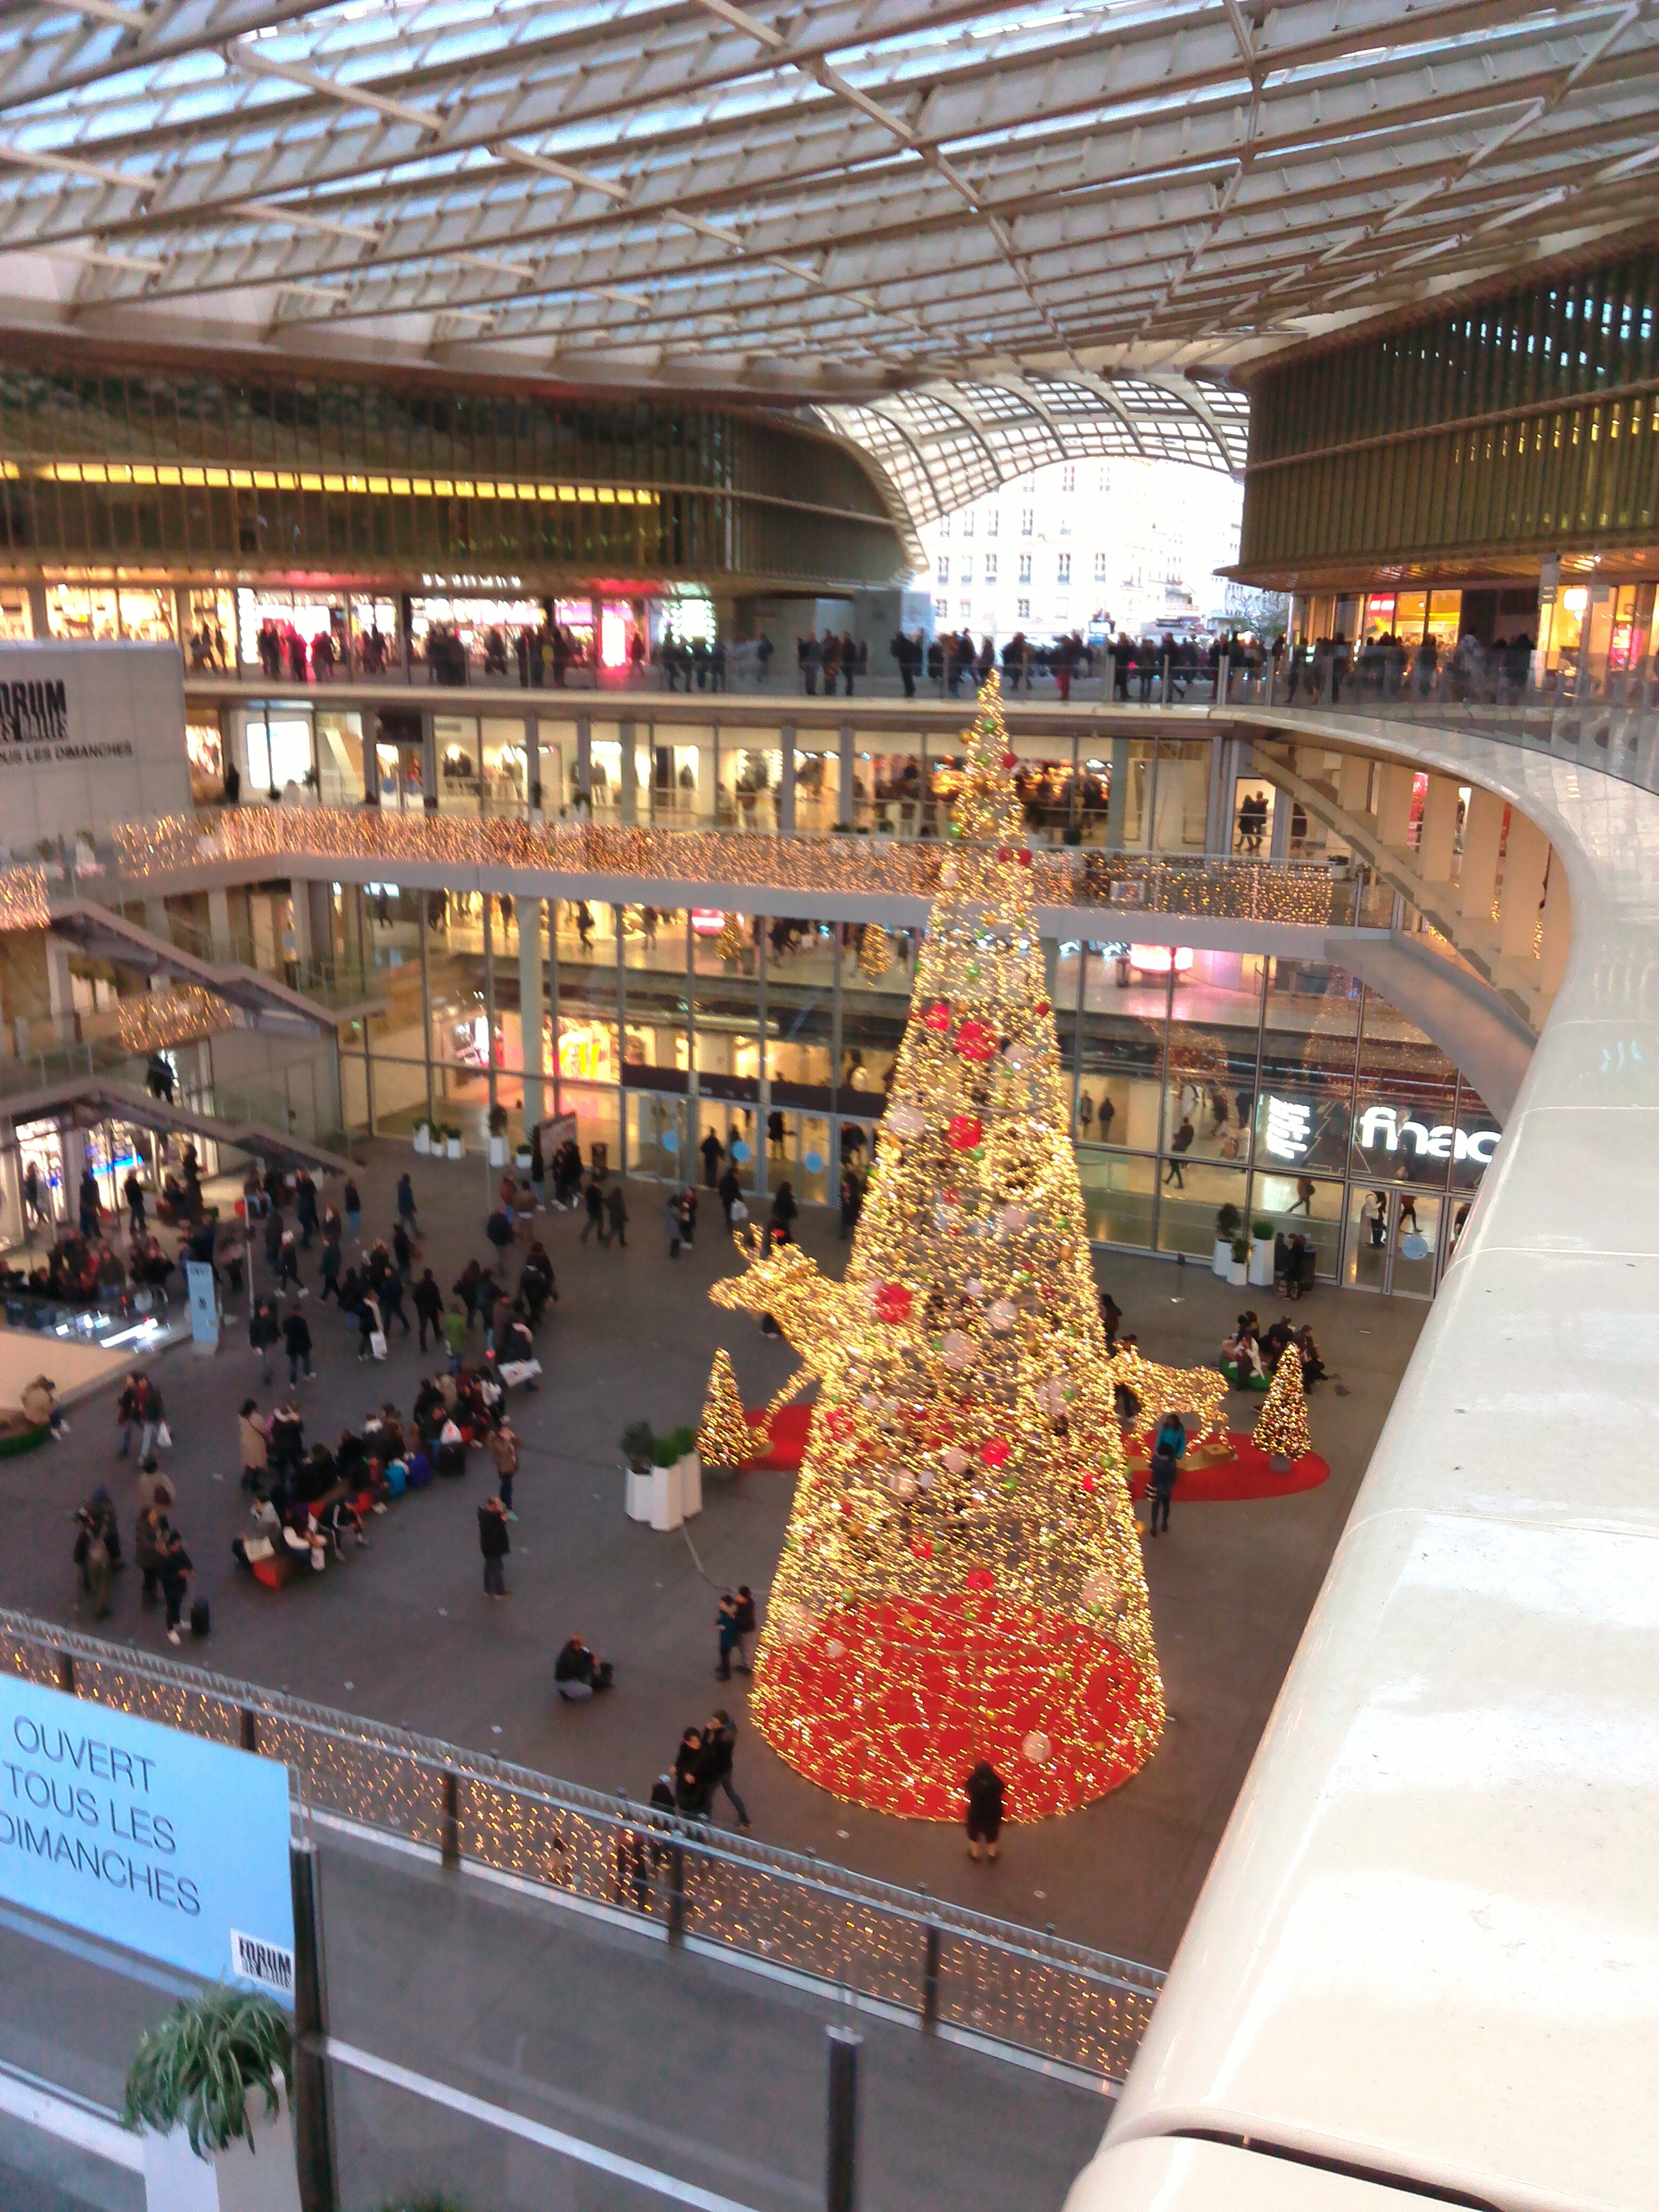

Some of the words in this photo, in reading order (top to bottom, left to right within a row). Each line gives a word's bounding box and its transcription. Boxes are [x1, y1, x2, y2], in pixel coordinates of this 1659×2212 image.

[1360, 1106, 1502, 1163] fnac
[13, 1715, 156, 1794] OUVERT
[2, 1760, 99, 1828] TOUS
[110, 1798, 177, 1855] LES
